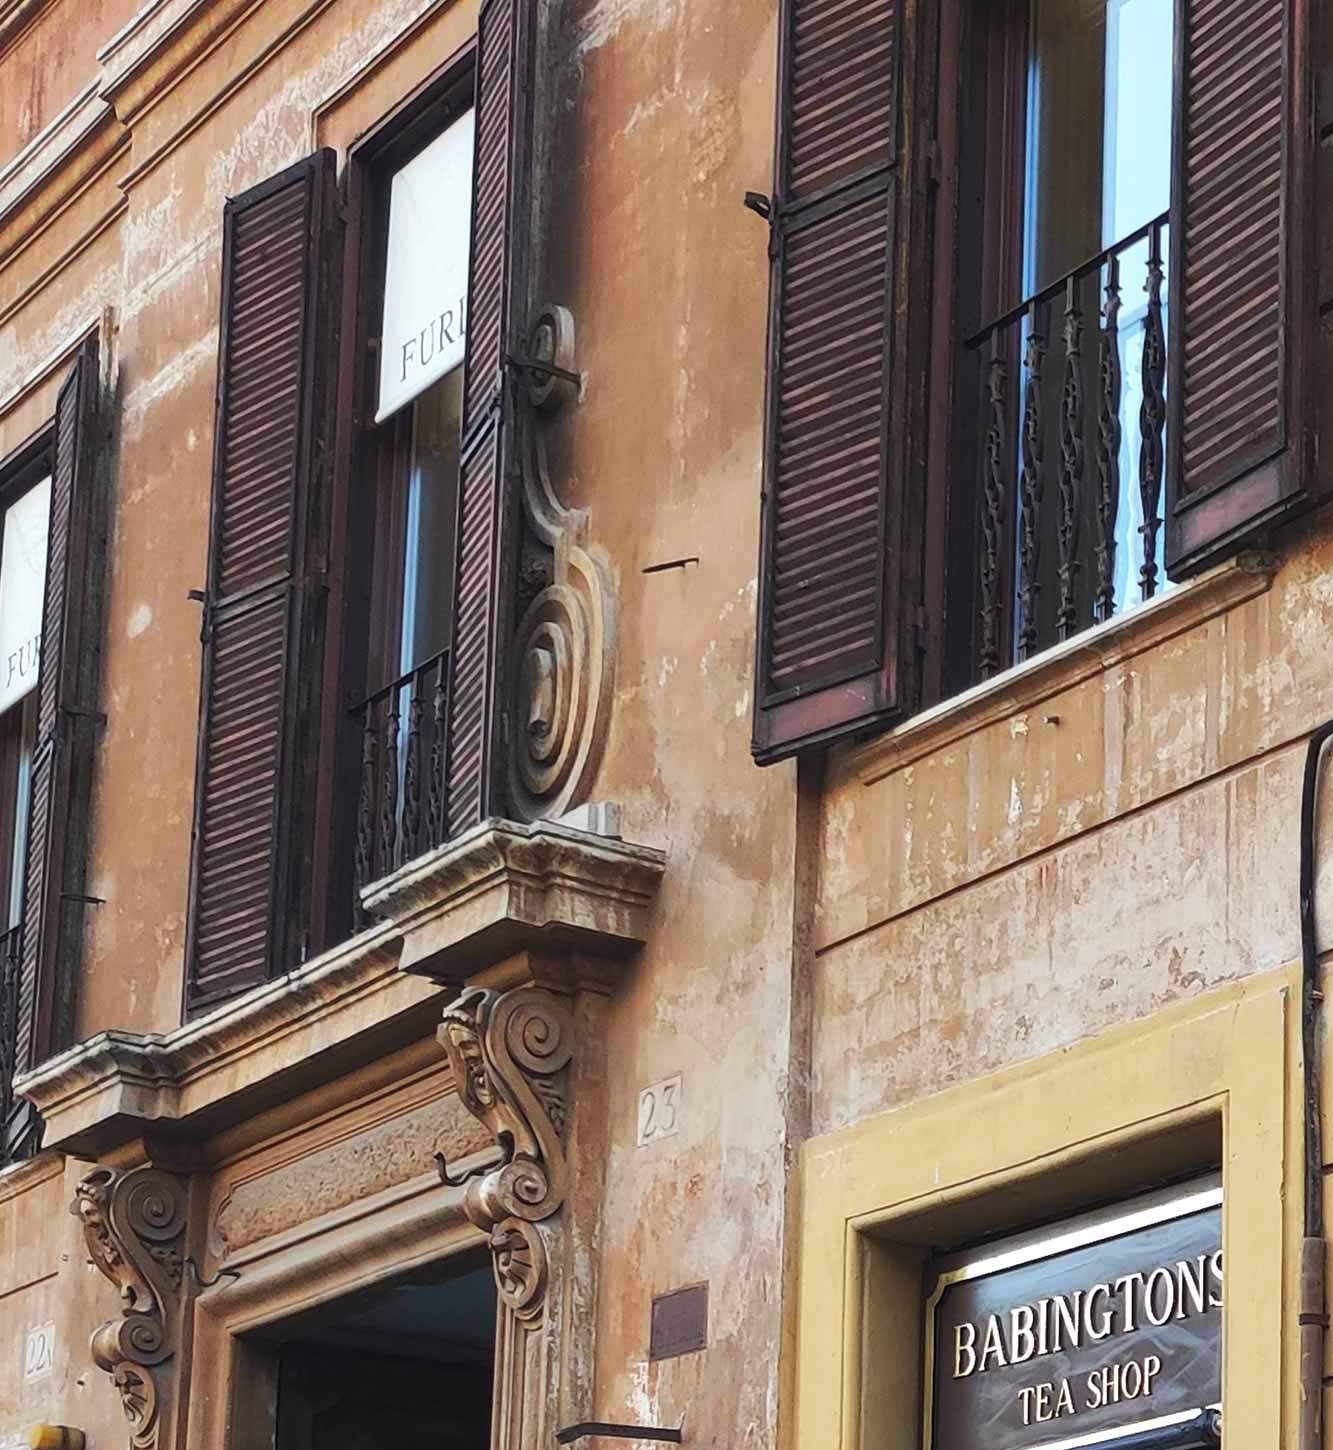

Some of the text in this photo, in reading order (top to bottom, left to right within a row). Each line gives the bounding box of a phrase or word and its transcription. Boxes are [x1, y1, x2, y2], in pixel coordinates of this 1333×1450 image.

[642, 1084, 676, 1138] 23
[952, 1250, 1223, 1379] BABINGTONS
[1017, 1356, 1161, 1425] TEA SHOP
